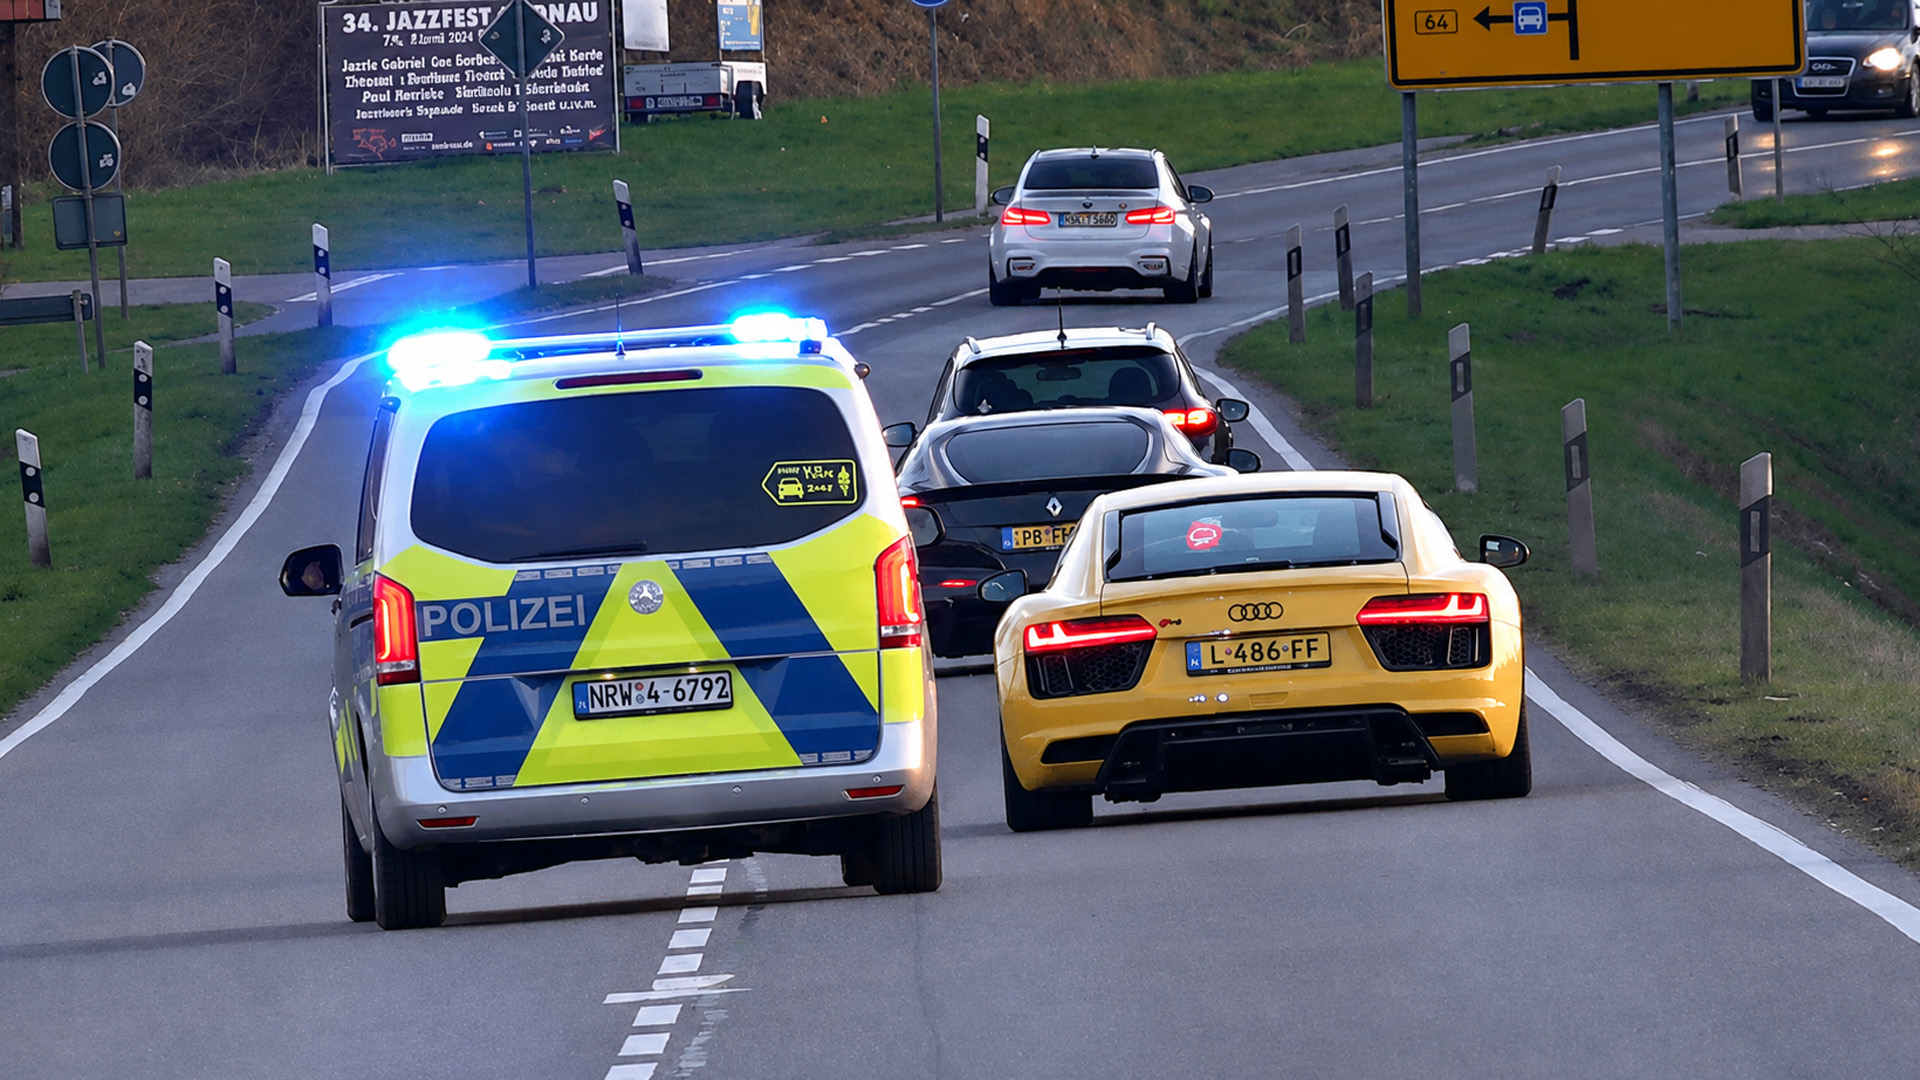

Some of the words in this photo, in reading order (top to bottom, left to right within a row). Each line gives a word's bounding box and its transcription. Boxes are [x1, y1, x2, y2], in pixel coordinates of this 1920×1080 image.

[343, 13, 379, 33] 34.
[386, 6, 492, 31] JAZZFEST
[1424, 14, 1449, 30] 64
[448, 31, 474, 43] 2024
[381, 56, 425, 70] Gabriel
[362, 90, 391, 103] Paul
[1022, 529, 1042, 546] PB
[422, 594, 586, 637] POLIZEI
[1211, 644, 1224, 665] L
[1234, 640, 1280, 663] 486
[1291, 638, 1319, 659] FF
[590, 682, 632, 709] NRW
[647, 676, 729, 703] 4-6792
